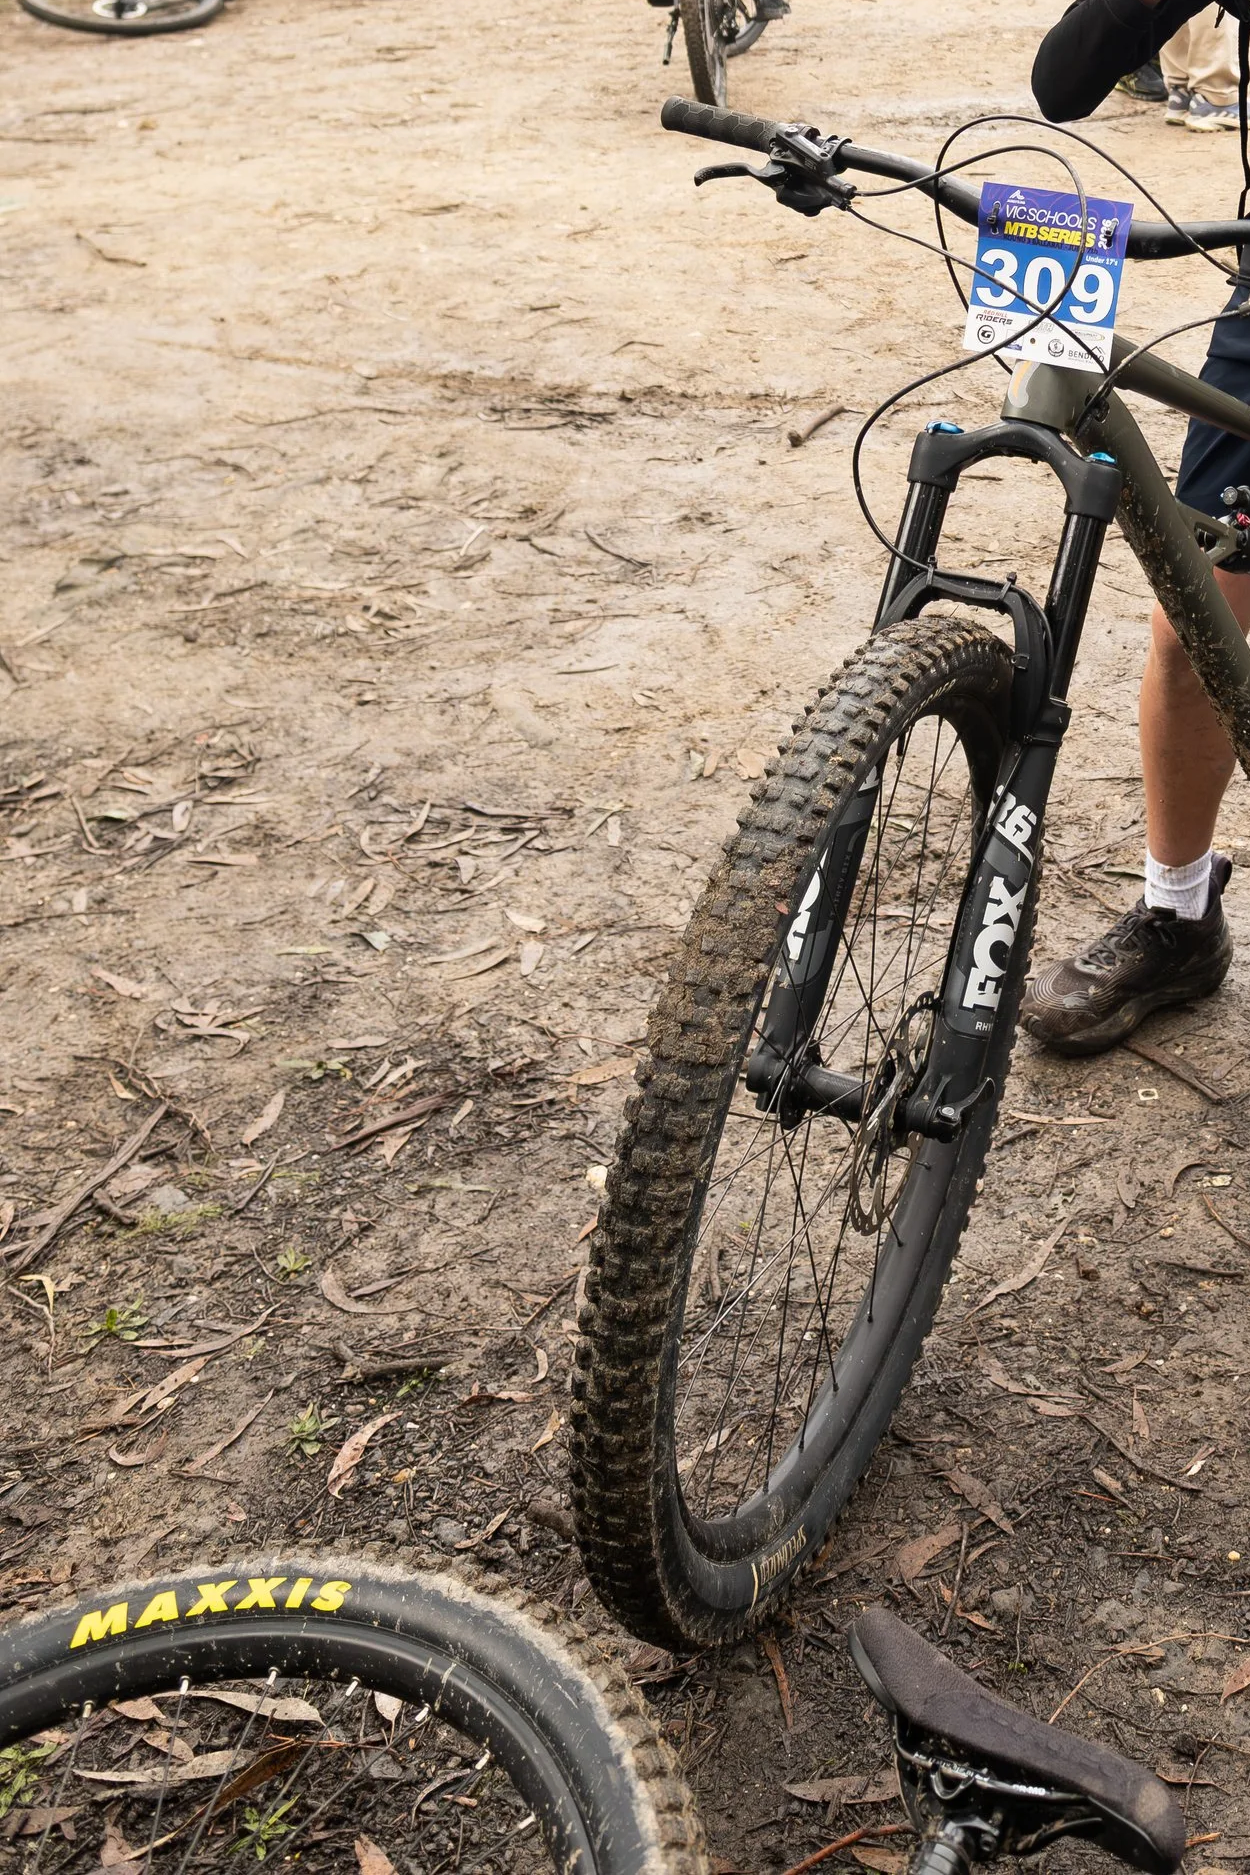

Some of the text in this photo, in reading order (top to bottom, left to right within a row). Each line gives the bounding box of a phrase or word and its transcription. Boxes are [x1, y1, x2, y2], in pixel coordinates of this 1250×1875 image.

[975, 248, 1114, 324] 309
[1085, 255, 1105, 264] Under
[975, 313, 1013, 326] RIDERS
[962, 876, 1030, 1012] FOX
[69, 1576, 353, 1649] MAXXIS
